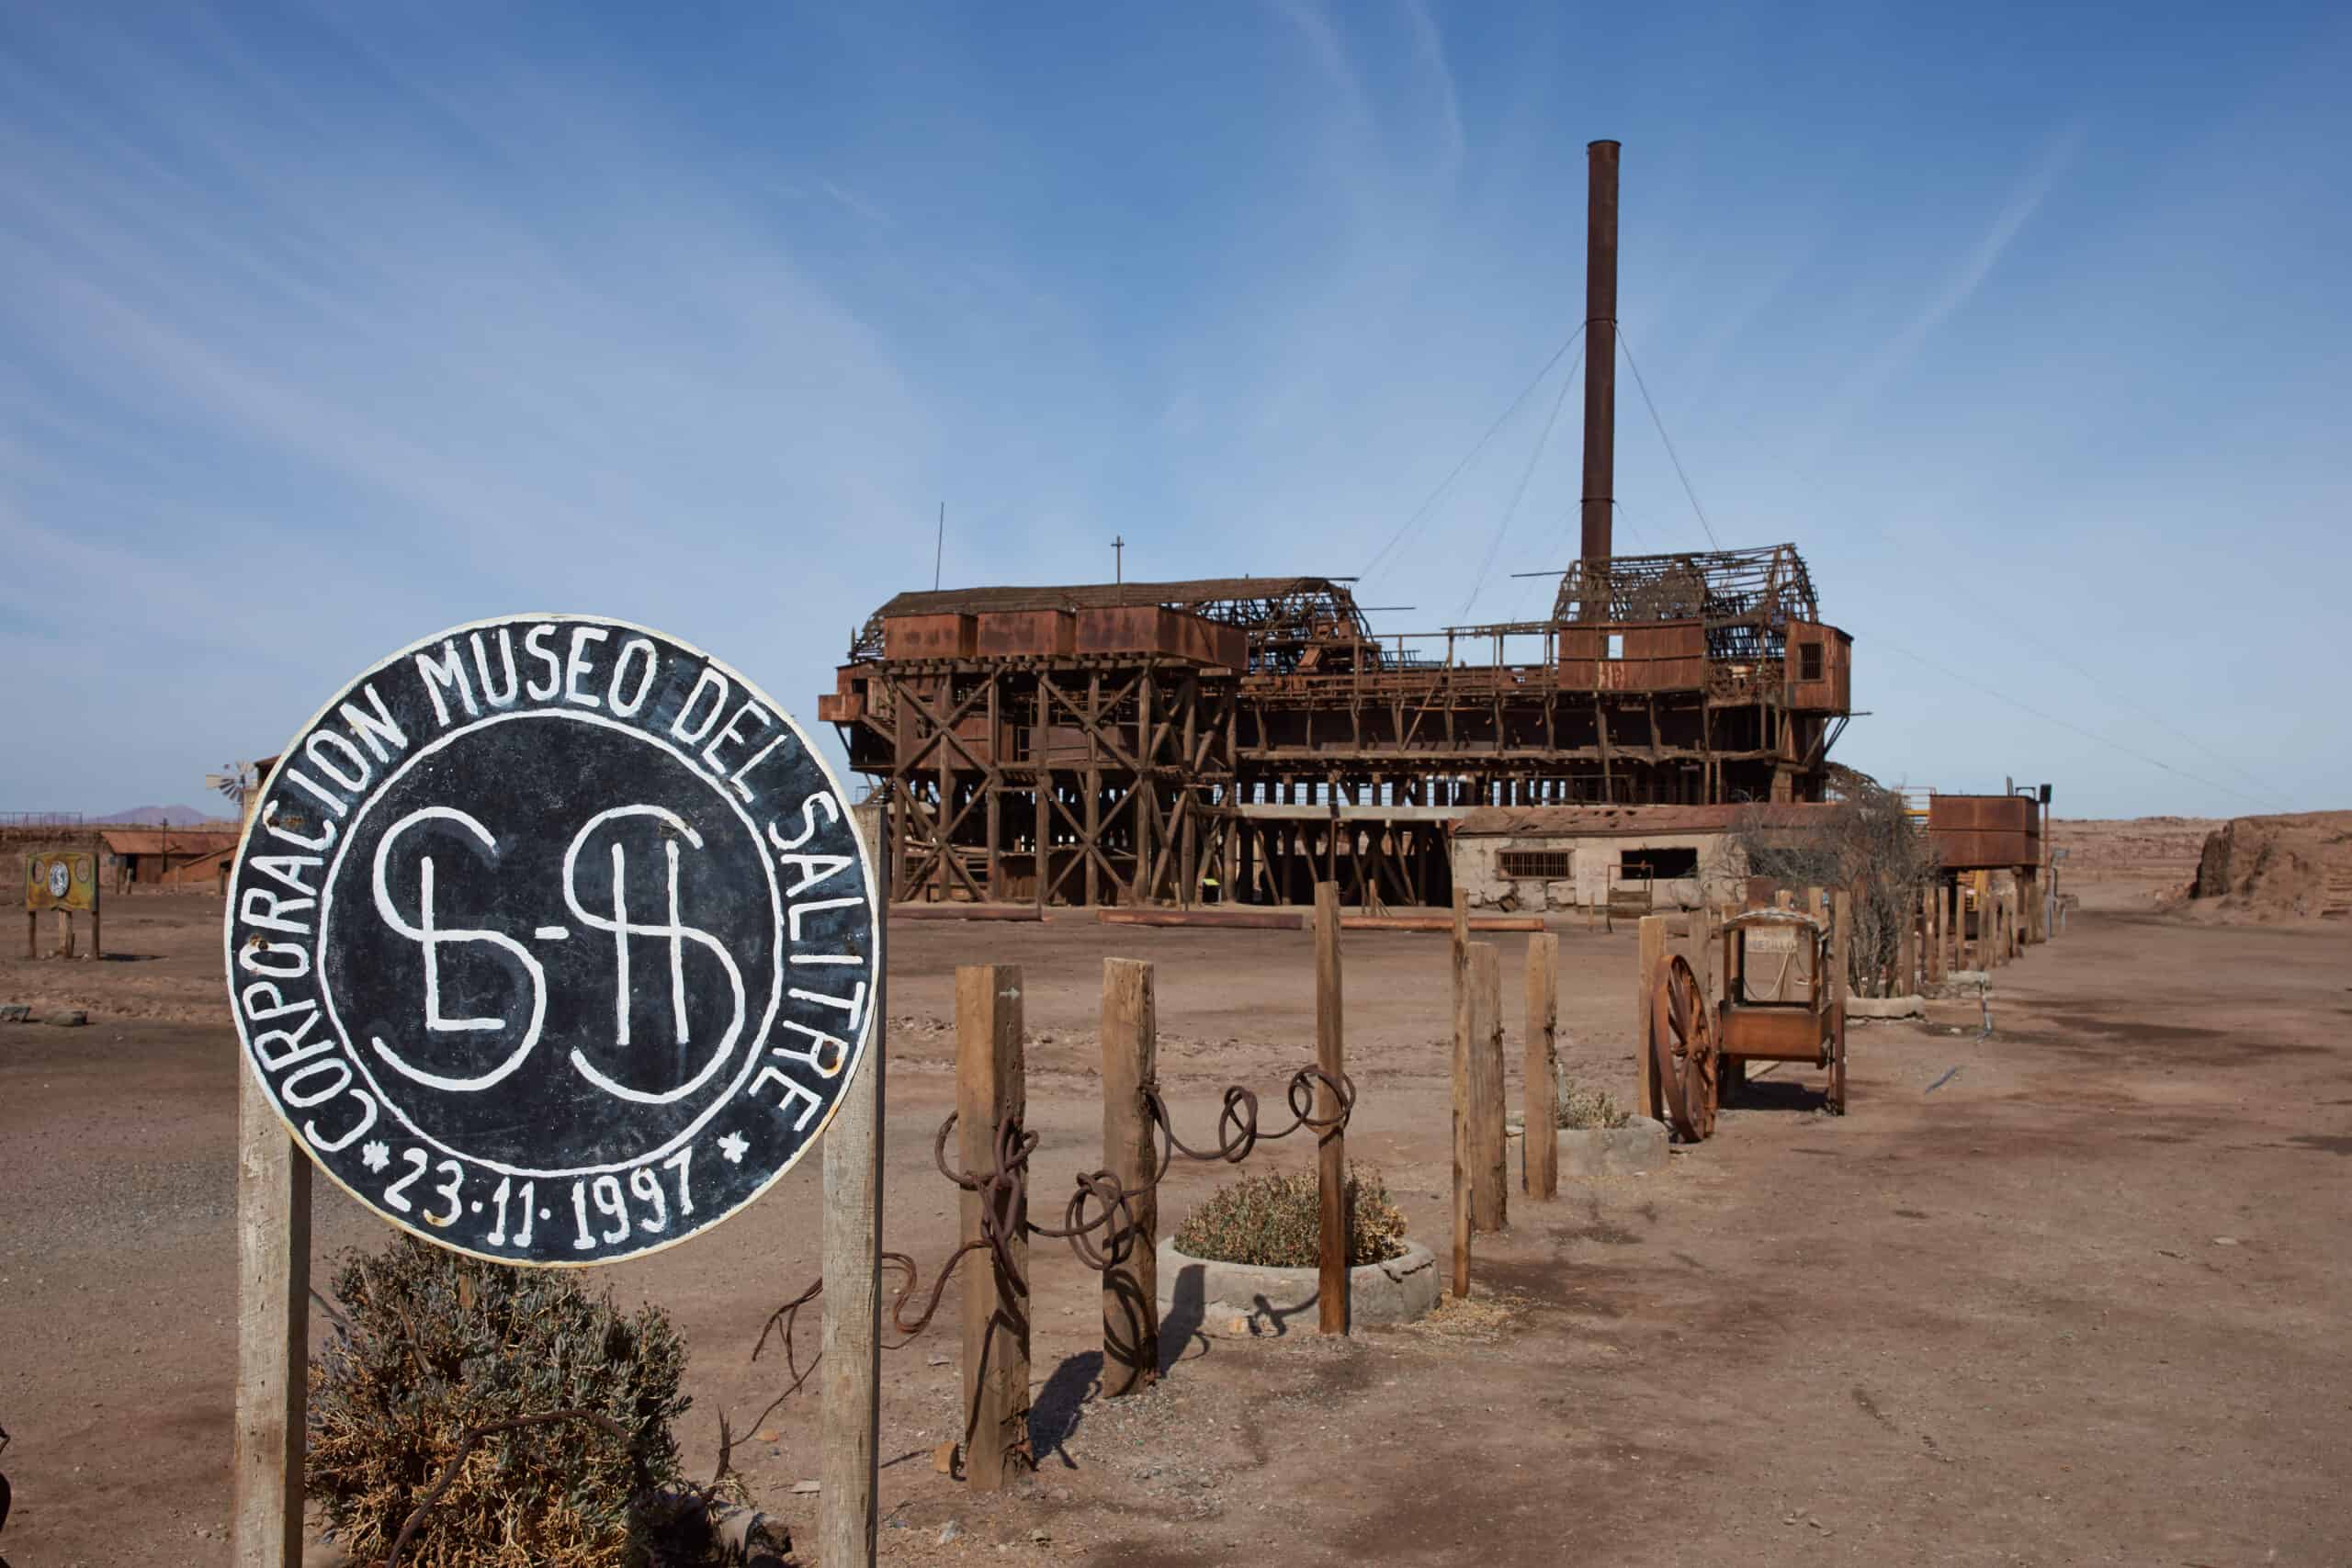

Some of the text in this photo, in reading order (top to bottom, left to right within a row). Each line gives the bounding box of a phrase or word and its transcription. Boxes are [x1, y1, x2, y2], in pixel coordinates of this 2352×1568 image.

[240, 625, 867, 1152] CORPORACION MUSEO DEL SALITRE
